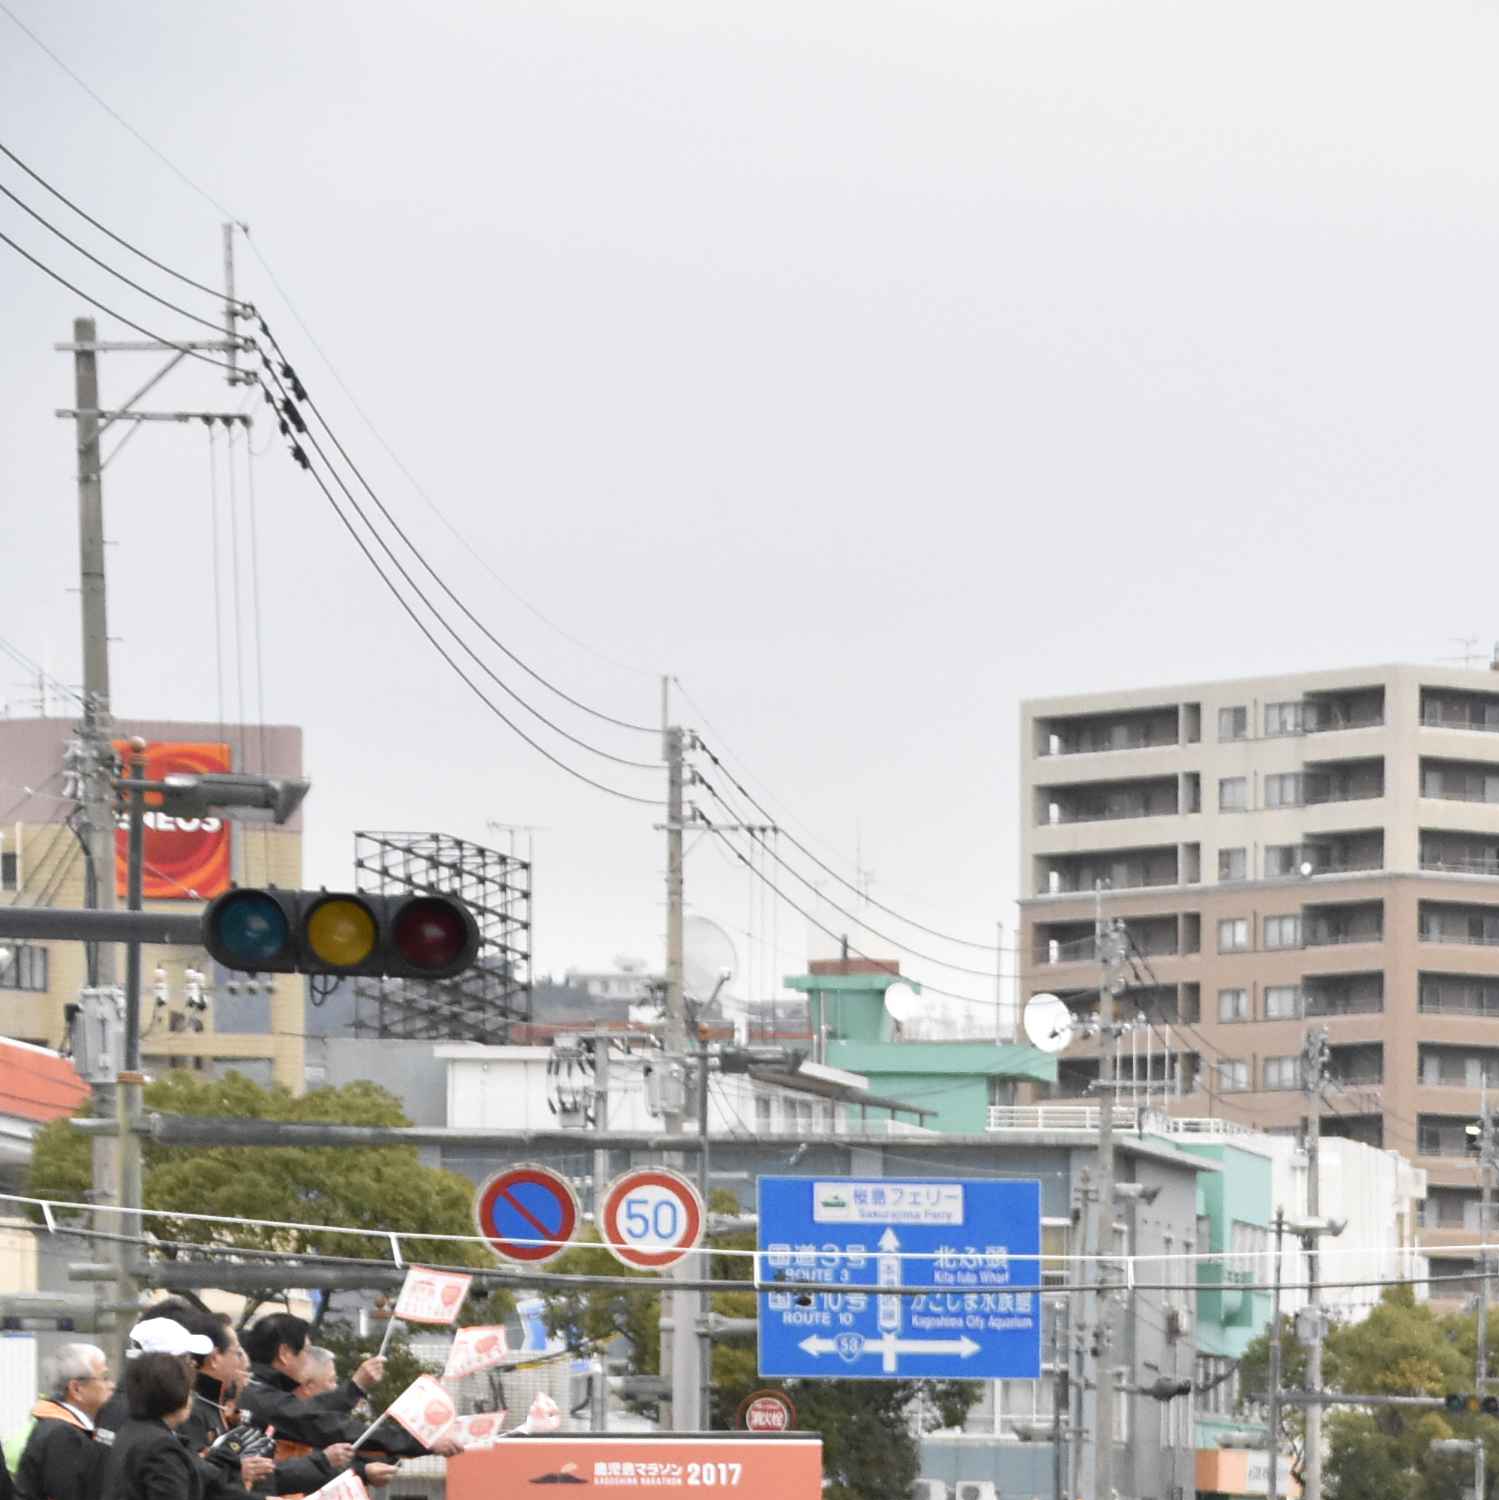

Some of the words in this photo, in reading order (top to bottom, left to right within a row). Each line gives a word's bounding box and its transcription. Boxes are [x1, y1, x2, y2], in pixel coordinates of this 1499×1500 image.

[853, 1188, 960, 1206] 桜島フェリー
[625, 1199, 677, 1239] 50
[934, 1246, 1009, 1269] 北ふ頭
[840, 1271, 849, 1281] 3
[911, 1293, 1032, 1312] かごしま水族館
[783, 1312, 831, 1325] ROUTE
[839, 1312, 853, 1325] 10
[912, 1314, 963, 1329] Kagoshima
[966, 1315, 985, 1330] City
[988, 1315, 1032, 1328] Aquarium
[687, 1462, 742, 1486] 2017
